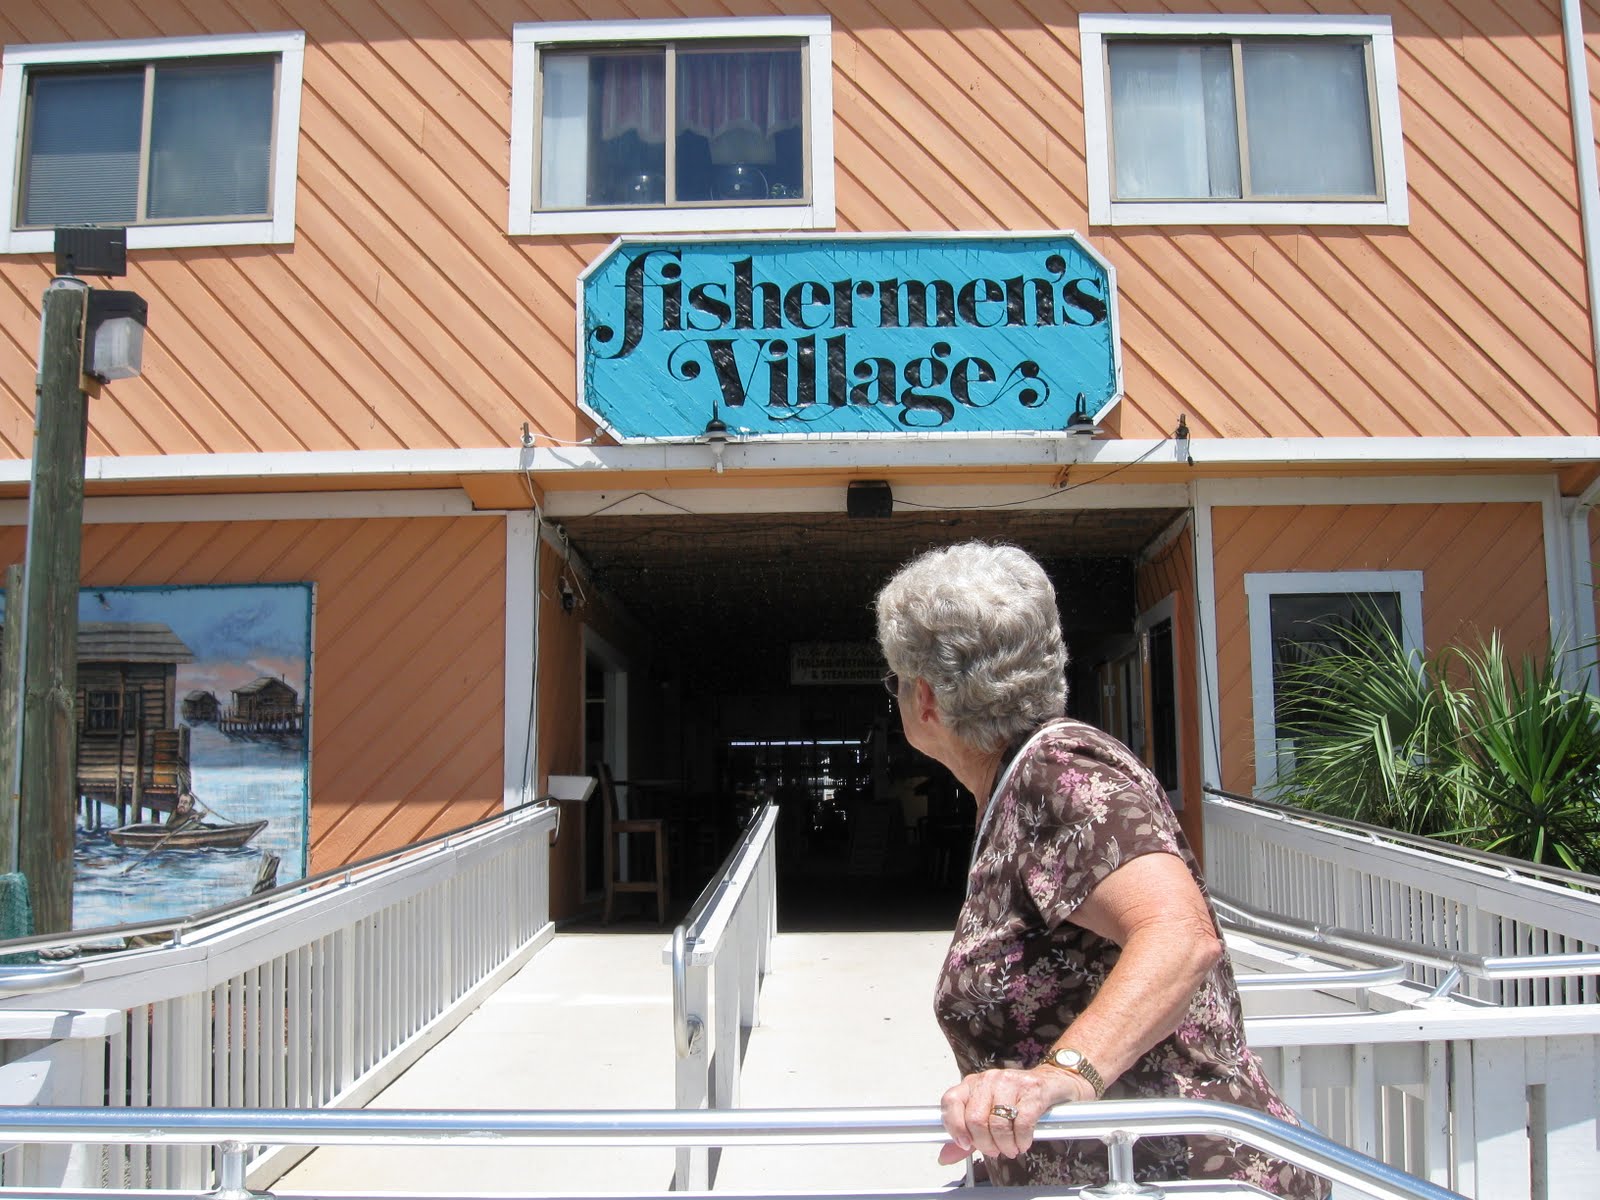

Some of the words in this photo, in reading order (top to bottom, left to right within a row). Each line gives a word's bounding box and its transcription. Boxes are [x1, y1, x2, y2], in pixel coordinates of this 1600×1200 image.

[588, 249, 1108, 360] fishermen's
[667, 334, 1050, 428] Village
[822, 670, 880, 680] STEAKHOUSE
